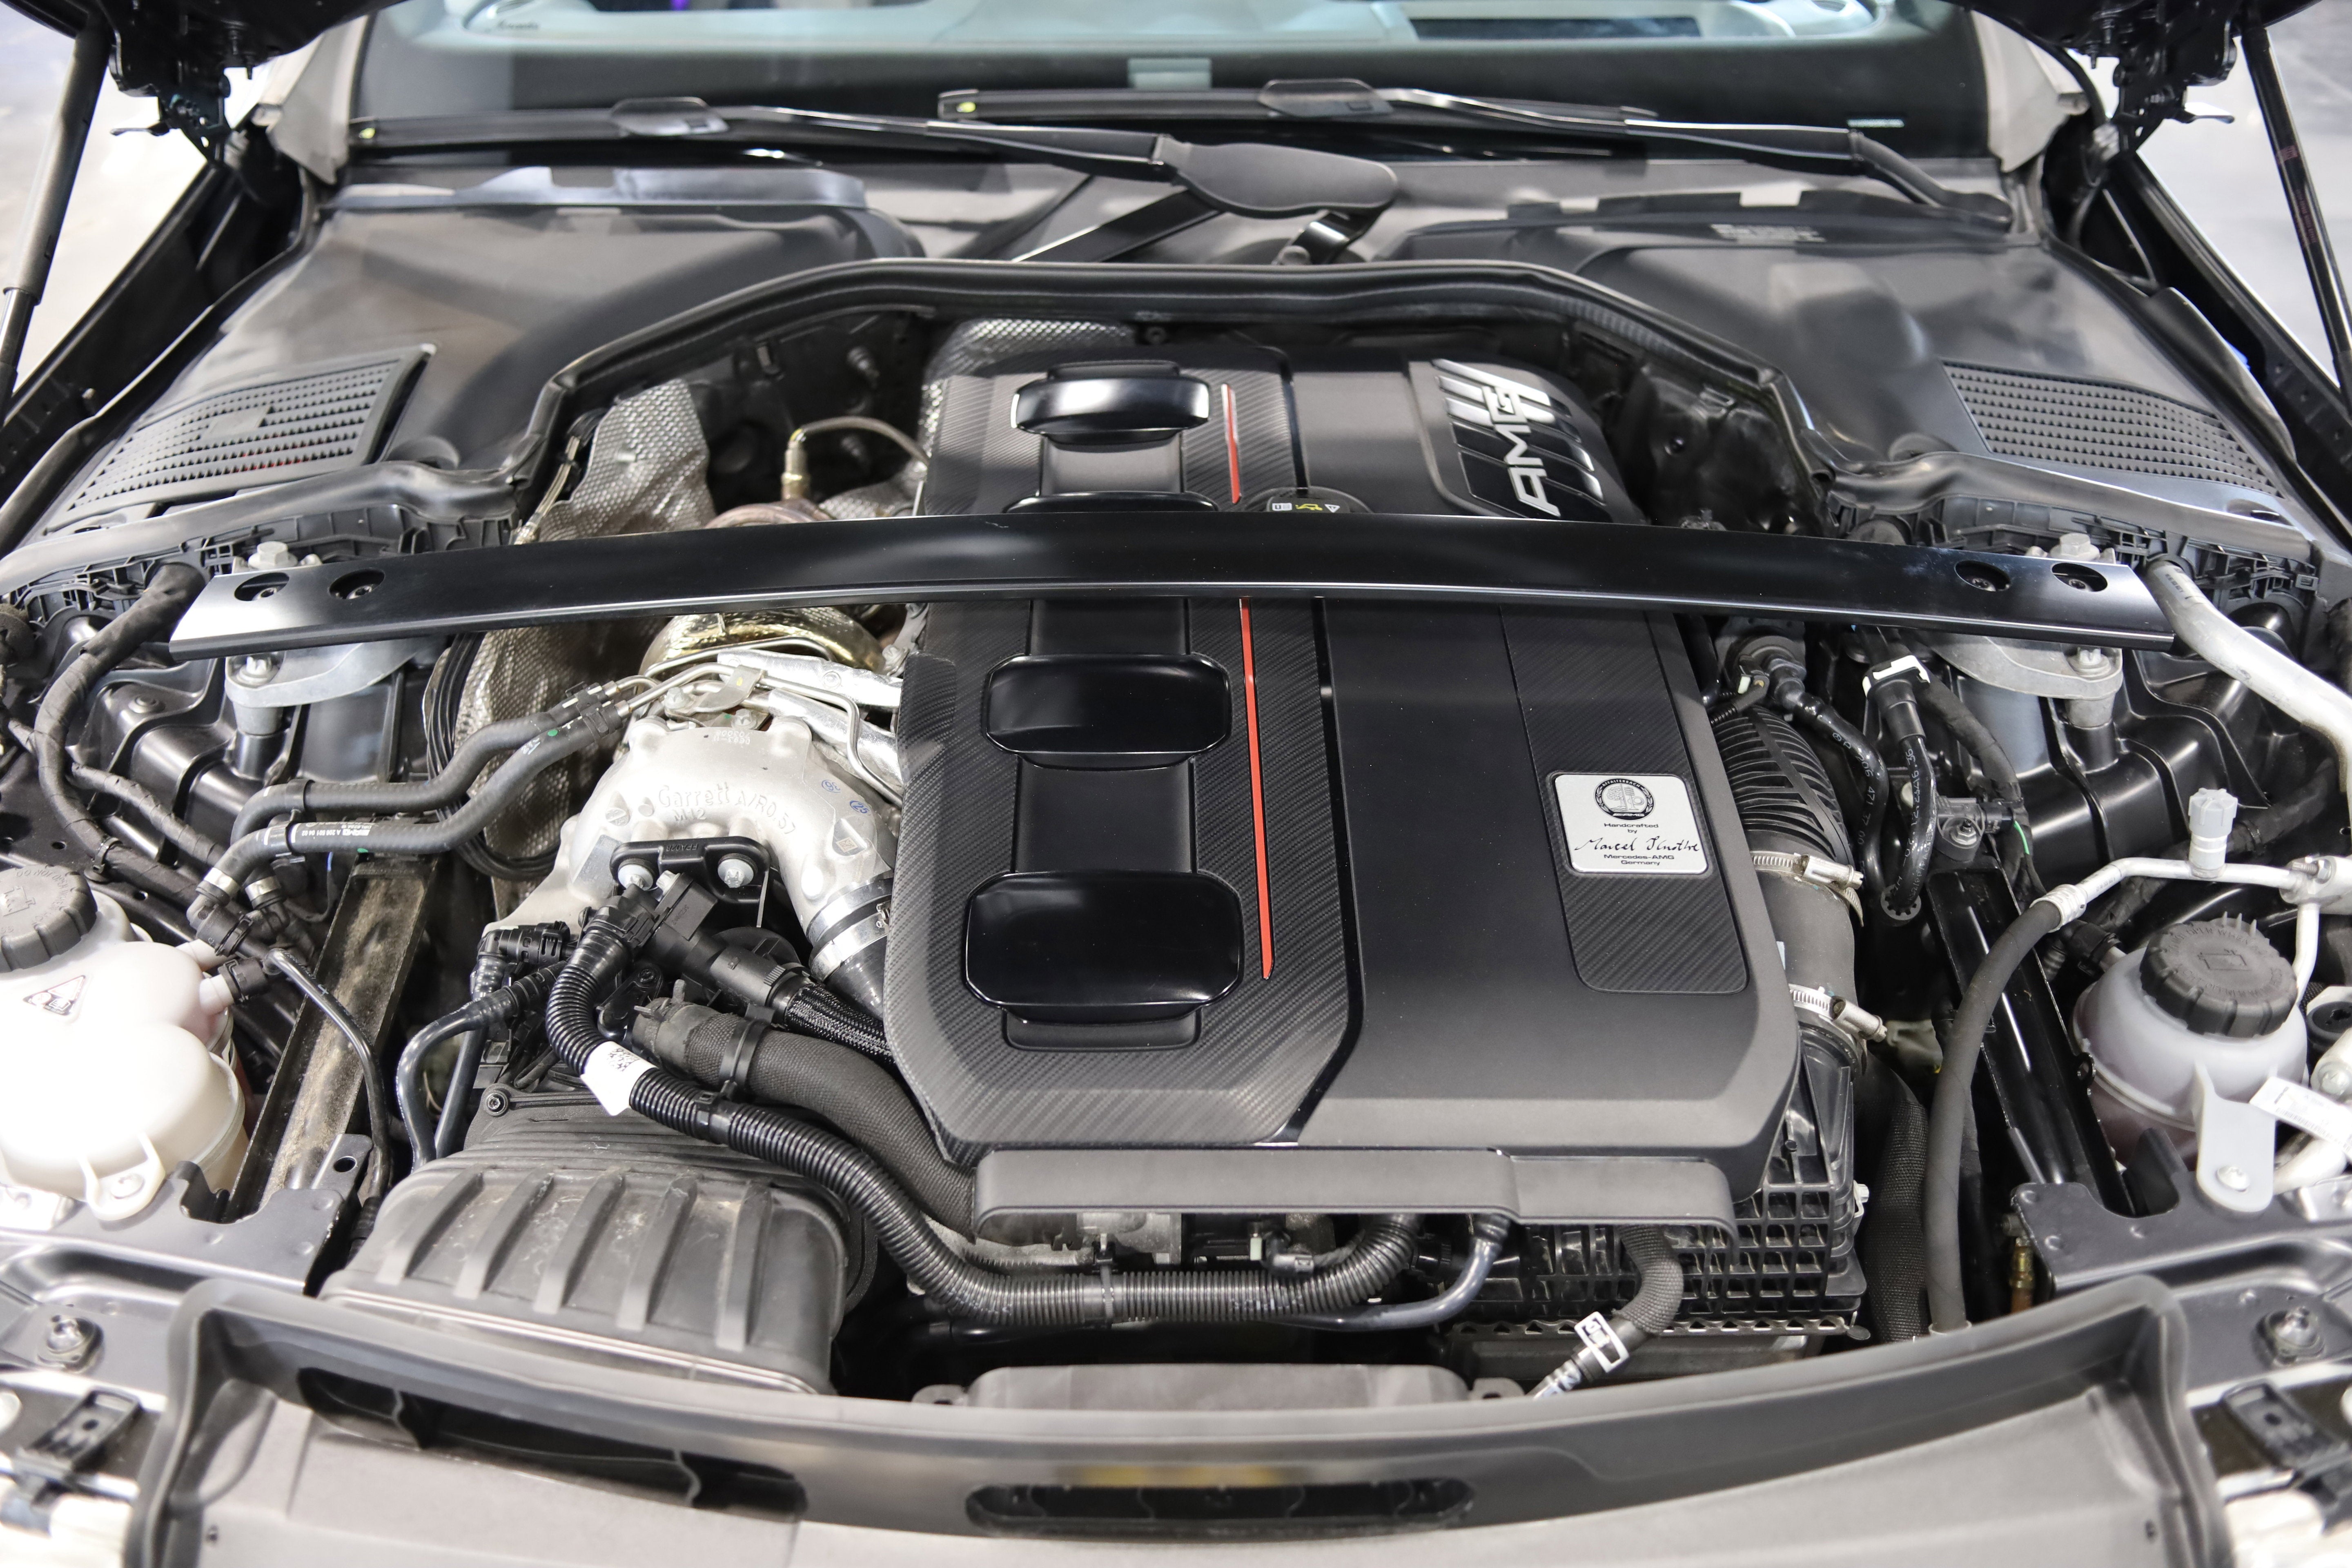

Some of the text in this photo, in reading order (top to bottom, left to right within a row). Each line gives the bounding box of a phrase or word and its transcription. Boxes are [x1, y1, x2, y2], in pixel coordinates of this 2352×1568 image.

[1482, 386, 1561, 517] AMG
[1601, 778, 1641, 788] AFFALTERBACH
[658, 782, 729, 807] Garrett
[1866, 786, 1875, 805] 471
[673, 807, 707, 822] M12
[666, 843, 698, 852] FPA028
